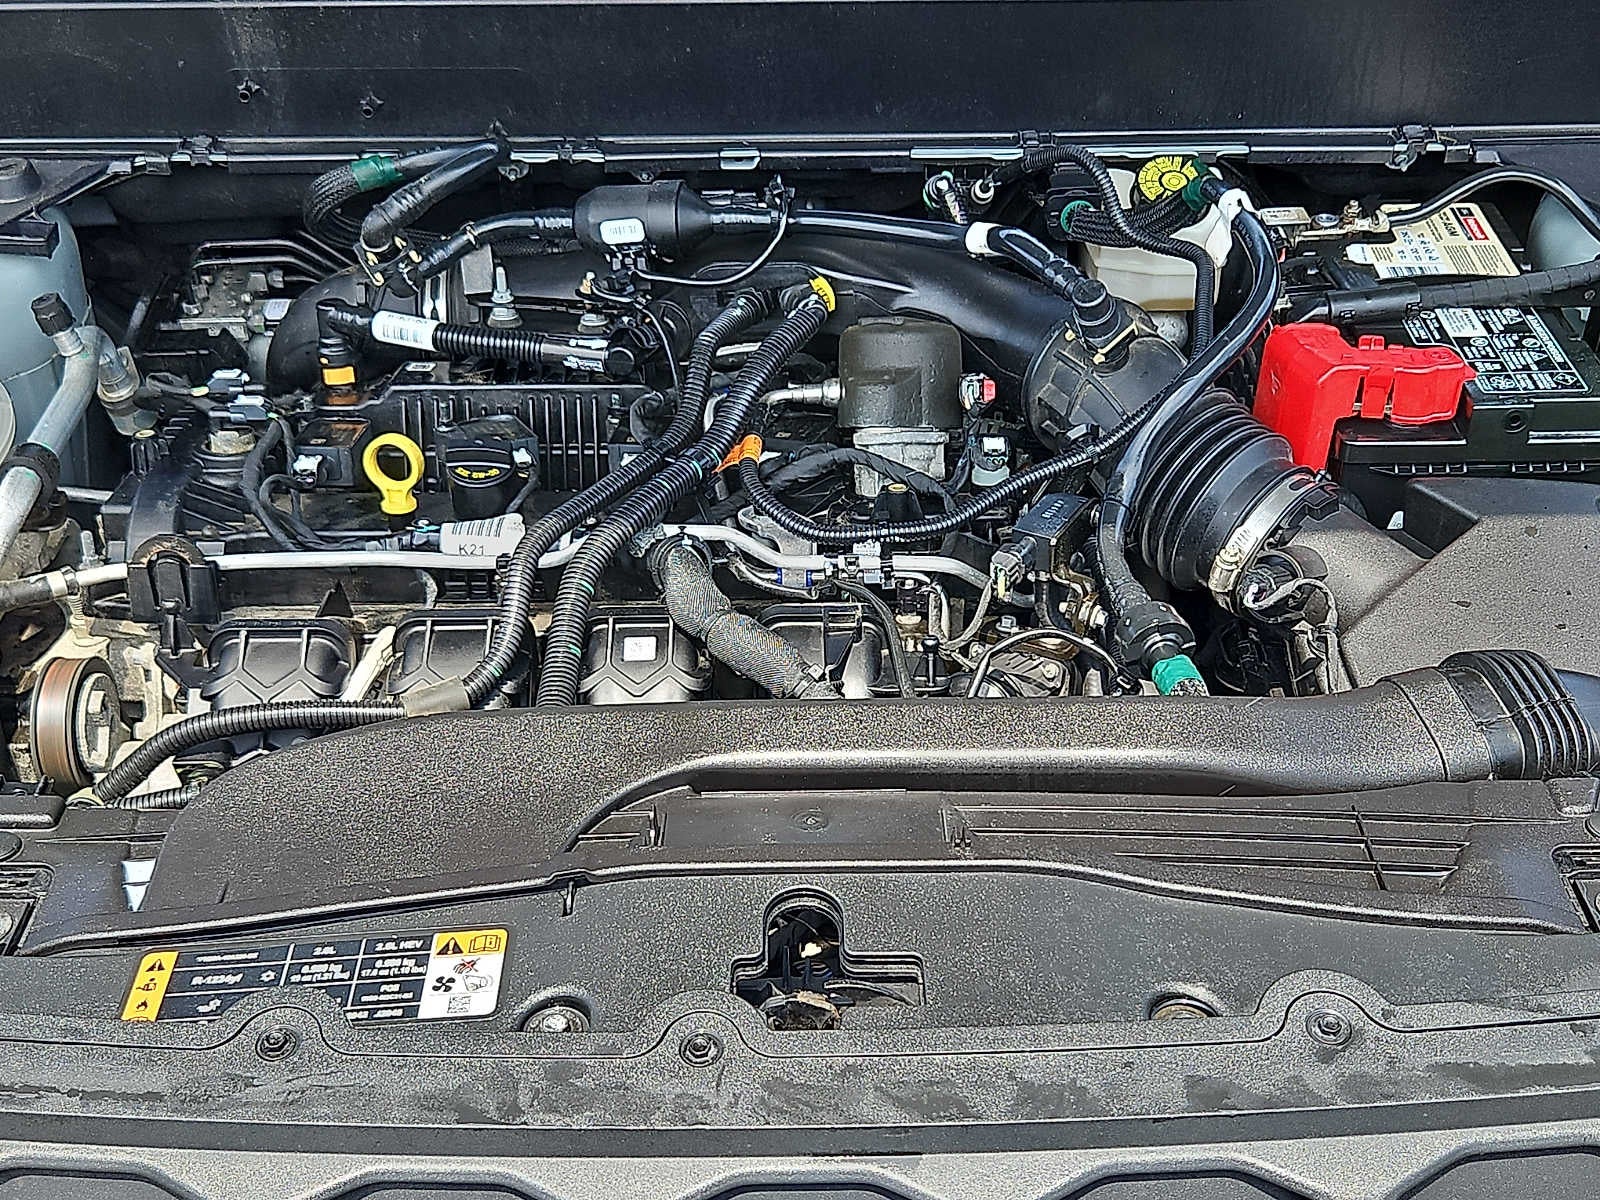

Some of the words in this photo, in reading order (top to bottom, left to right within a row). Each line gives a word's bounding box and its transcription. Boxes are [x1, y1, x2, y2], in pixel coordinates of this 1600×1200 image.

[1442, 222, 1460, 237] AGM
[458, 543, 485, 556] K21
[399, 939, 424, 950] HEV
